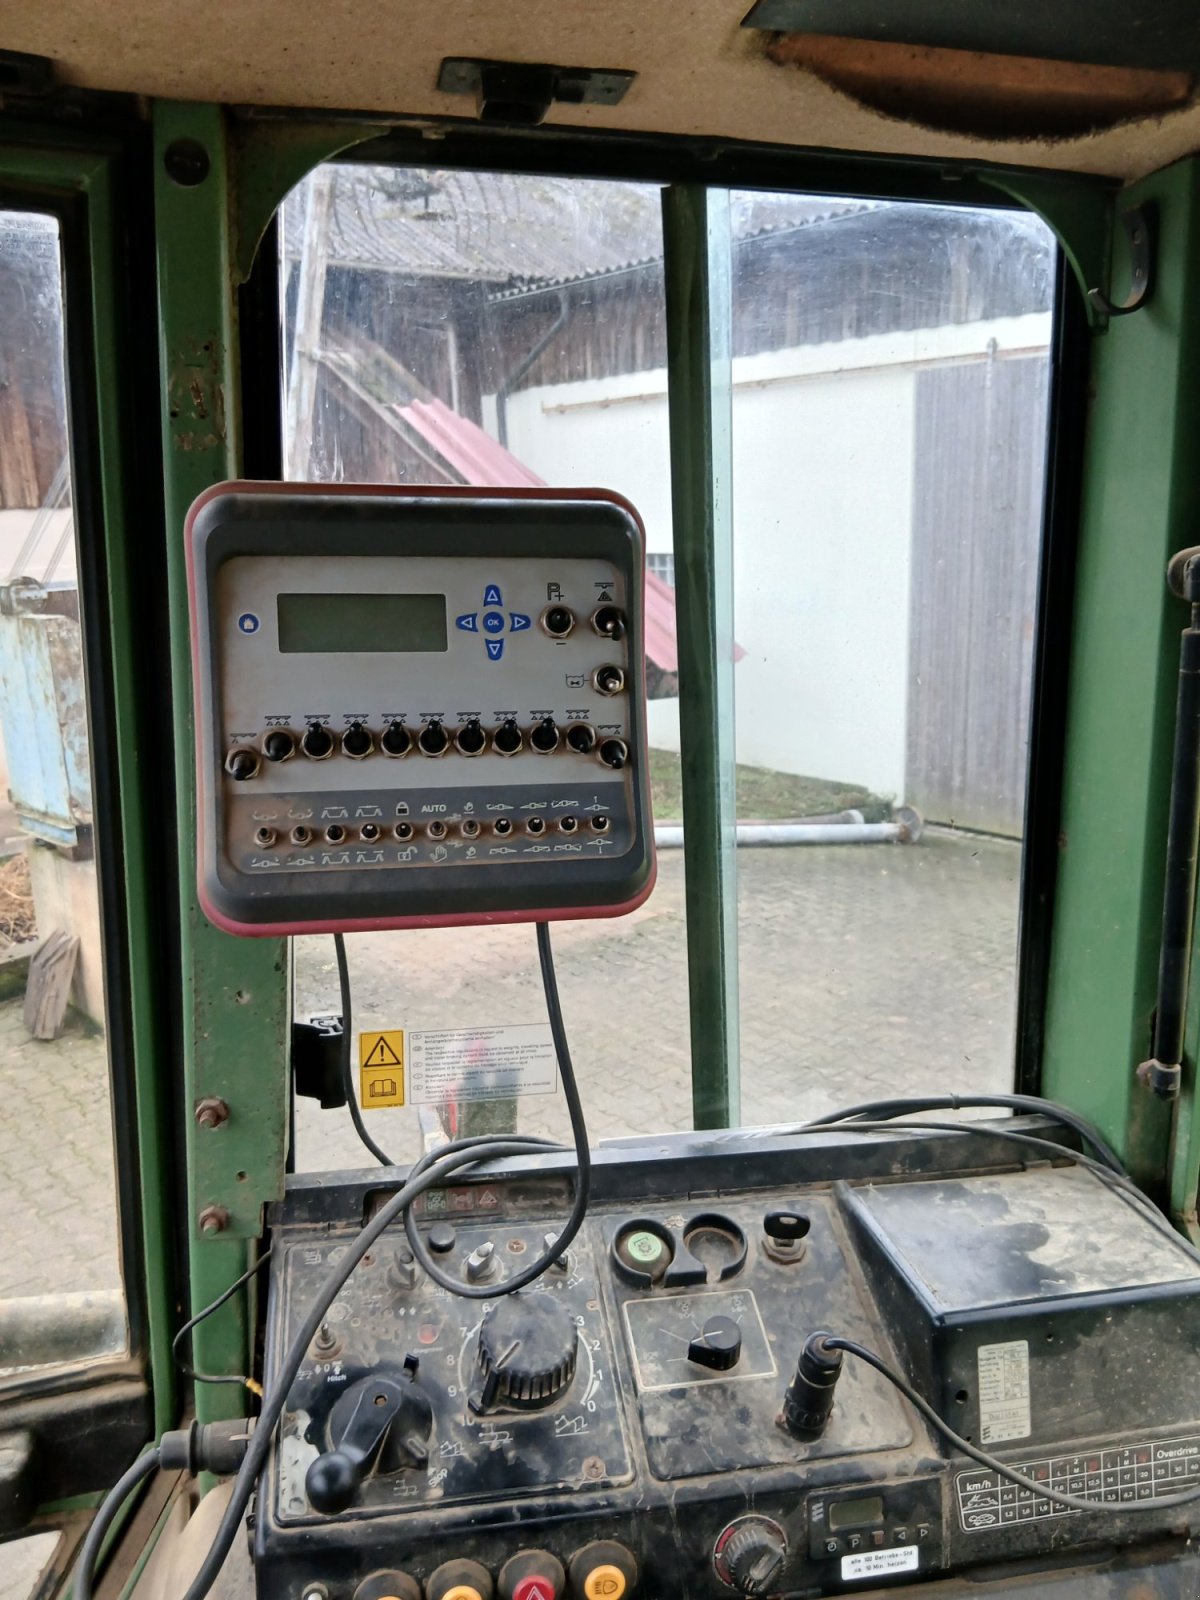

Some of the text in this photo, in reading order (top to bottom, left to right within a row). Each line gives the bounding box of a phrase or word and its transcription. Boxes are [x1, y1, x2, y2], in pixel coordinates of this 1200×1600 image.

[421, 804, 447, 814] AUTO
[482, 1302, 490, 1313] 6
[576, 1315, 586, 1326] 3
[459, 1326, 468, 1337] 7
[592, 1340, 601, 1351] 2
[446, 1354, 455, 1366] 8
[327, 1374, 346, 1383] Hitch
[597, 1370, 603, 1380] 1
[448, 1386, 457, 1397] 9
[586, 1400, 596, 1413] 0
[1157, 1447, 1198, 1459] Overdrive
[966, 1480, 992, 1490] km/h
[852, 1538, 859, 1548] P
